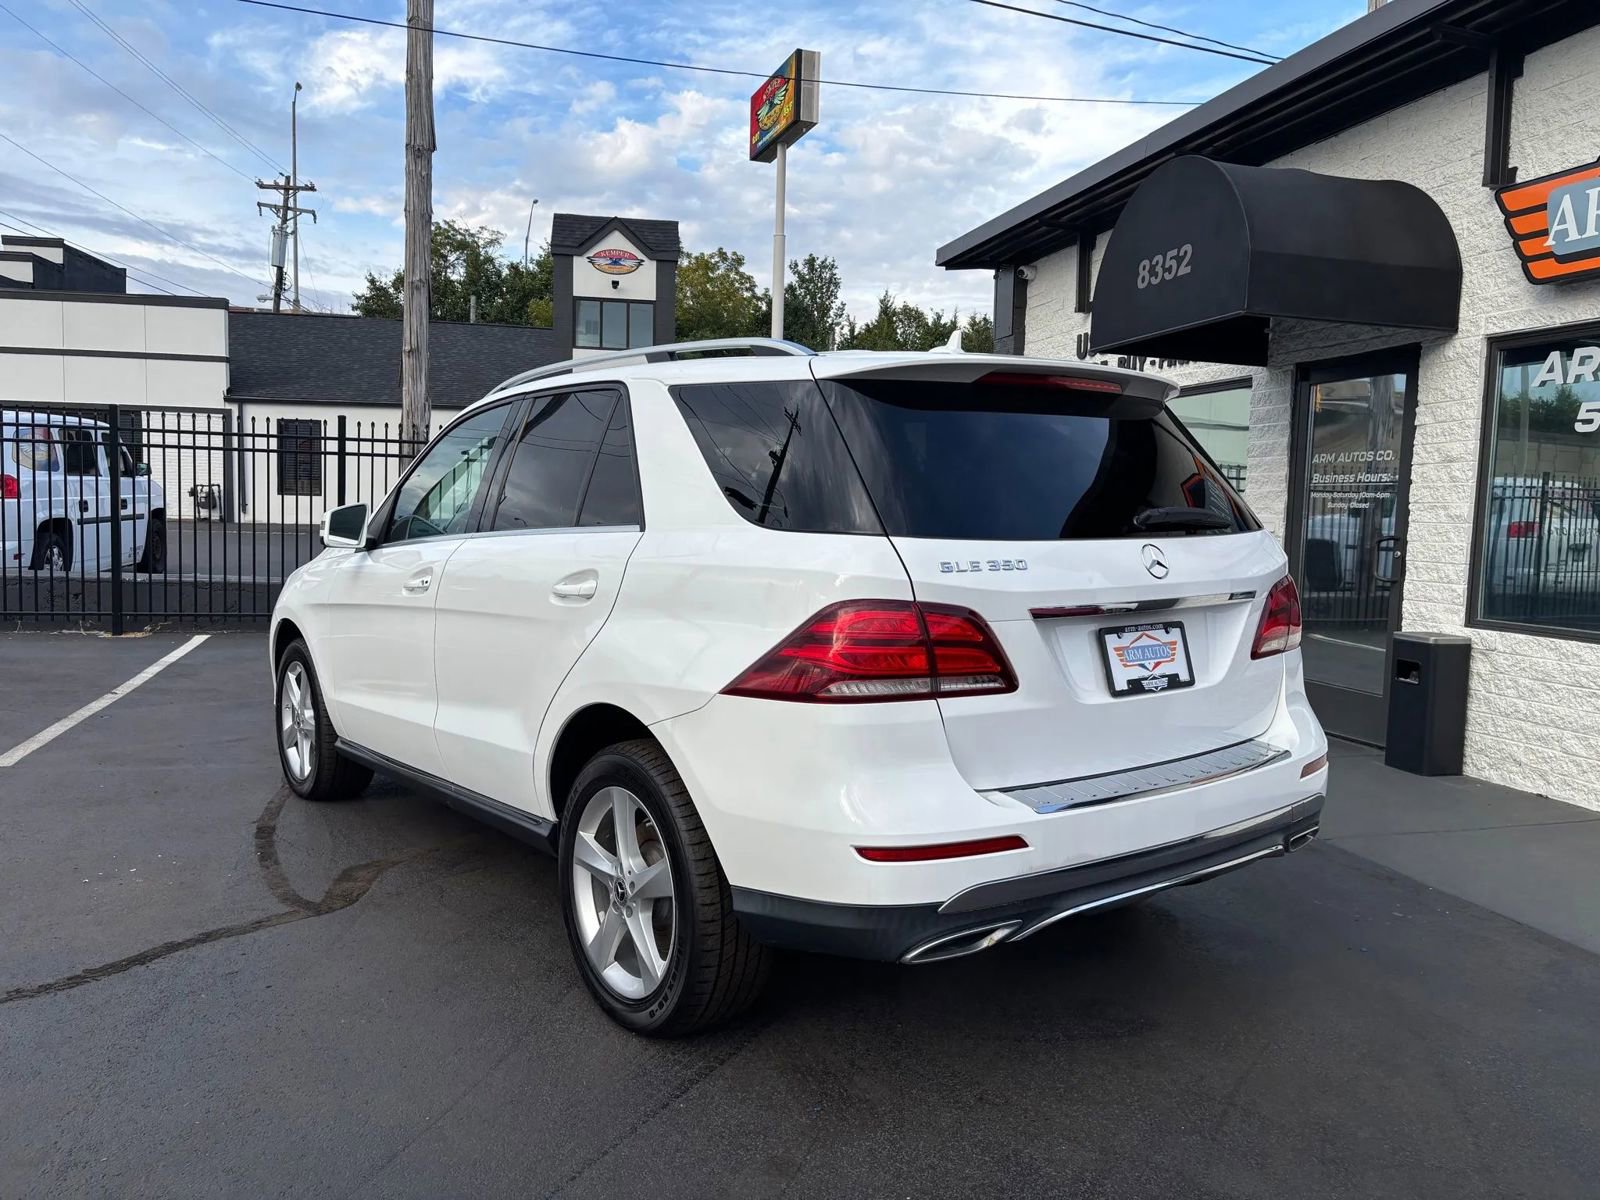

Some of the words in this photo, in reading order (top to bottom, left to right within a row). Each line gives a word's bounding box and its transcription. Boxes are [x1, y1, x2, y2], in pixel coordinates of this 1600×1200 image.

[600, 250, 630, 258] KEMPER
[1137, 243, 1193, 289] 8352
[1312, 453, 1336, 464] ARM
[1336, 451, 1374, 463] AUTOS
[1376, 449, 1395, 461] CO.
[1312, 472, 1355, 483] Business
[939, 560, 983, 573] GLE
[986, 559, 1028, 571] 350
[1124, 648, 1143, 660] ARM
[1144, 645, 1172, 659] AUTOS
